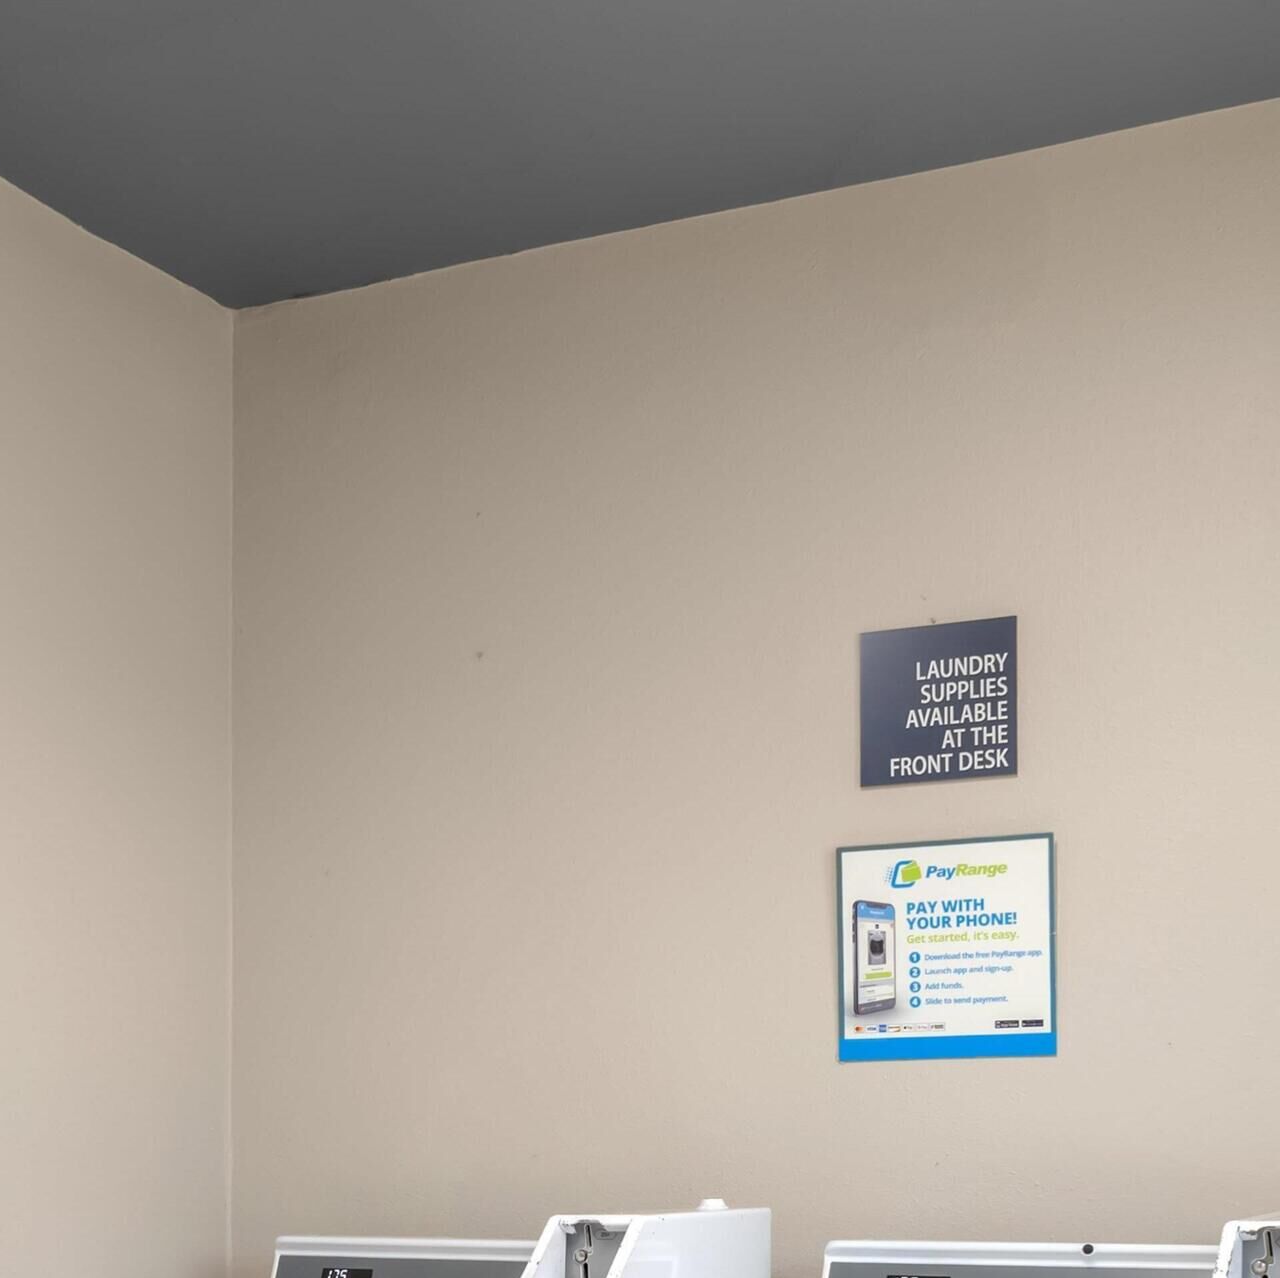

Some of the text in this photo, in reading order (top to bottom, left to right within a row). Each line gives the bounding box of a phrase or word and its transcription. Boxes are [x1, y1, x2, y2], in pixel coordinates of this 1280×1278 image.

[916, 652, 1008, 681] LAUNDRY
[920, 676, 1008, 704] SUPPLIES
[905, 700, 1008, 729] AVAILABLE
[941, 724, 1008, 749] AT THE
[890, 748, 1009, 777] FRONT DESK
[925, 863, 1008, 880] PayRange
[906, 898, 985, 915] PAY WITH
[906, 912, 1017, 930] YOUR PHONE!
[906, 930, 1020, 944] Get started, it's easy.
[924, 952, 961, 961] Download
[962, 951, 974, 959] the
[991, 949, 1026, 958] PayRange
[924, 967, 952, 975] Launch
[953, 967, 968, 975] app
[969, 965, 984, 973] and
[924, 982, 940, 990] Add
[941, 981, 964, 989] funds.
[925, 997, 943, 1005] Slide
[953, 996, 972, 1004] send
[972, 995, 1008, 1005] payment.
